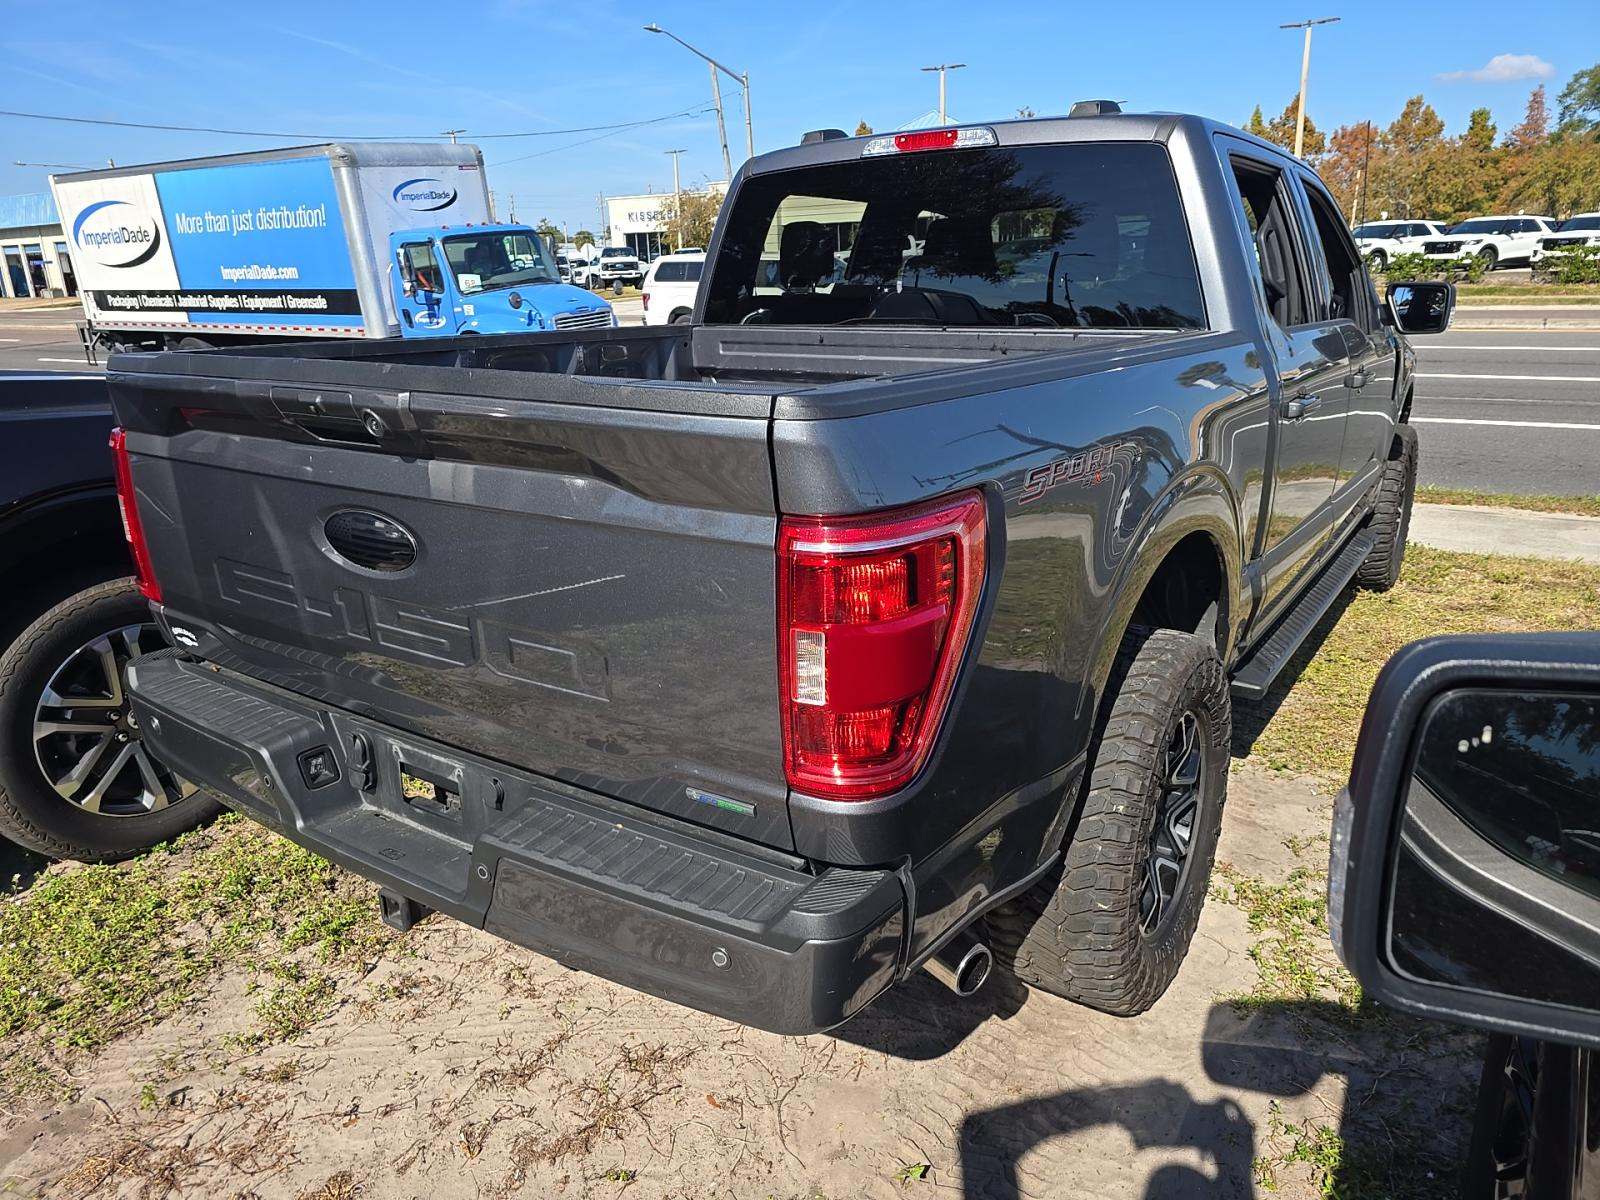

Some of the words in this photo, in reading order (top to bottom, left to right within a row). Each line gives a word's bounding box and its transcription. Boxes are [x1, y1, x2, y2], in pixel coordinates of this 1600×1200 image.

[401, 190, 451, 202] ImperialDade
[175, 211, 203, 234] More
[205, 210, 230, 233] than
[231, 209, 254, 236] just
[256, 203, 327, 231] distribution!
[82, 226, 151, 249] ImperialDade
[220, 264, 299, 283] ImperialDade.com
[107, 294, 140, 310] Packaging
[141, 294, 175, 308] Chemicals
[177, 294, 209, 308] Janitorial
[208, 294, 239, 311] Supplies
[242, 294, 284, 311] Equipment
[286, 294, 329, 310] Greensafe
[1018, 439, 1122, 506] SPORT
